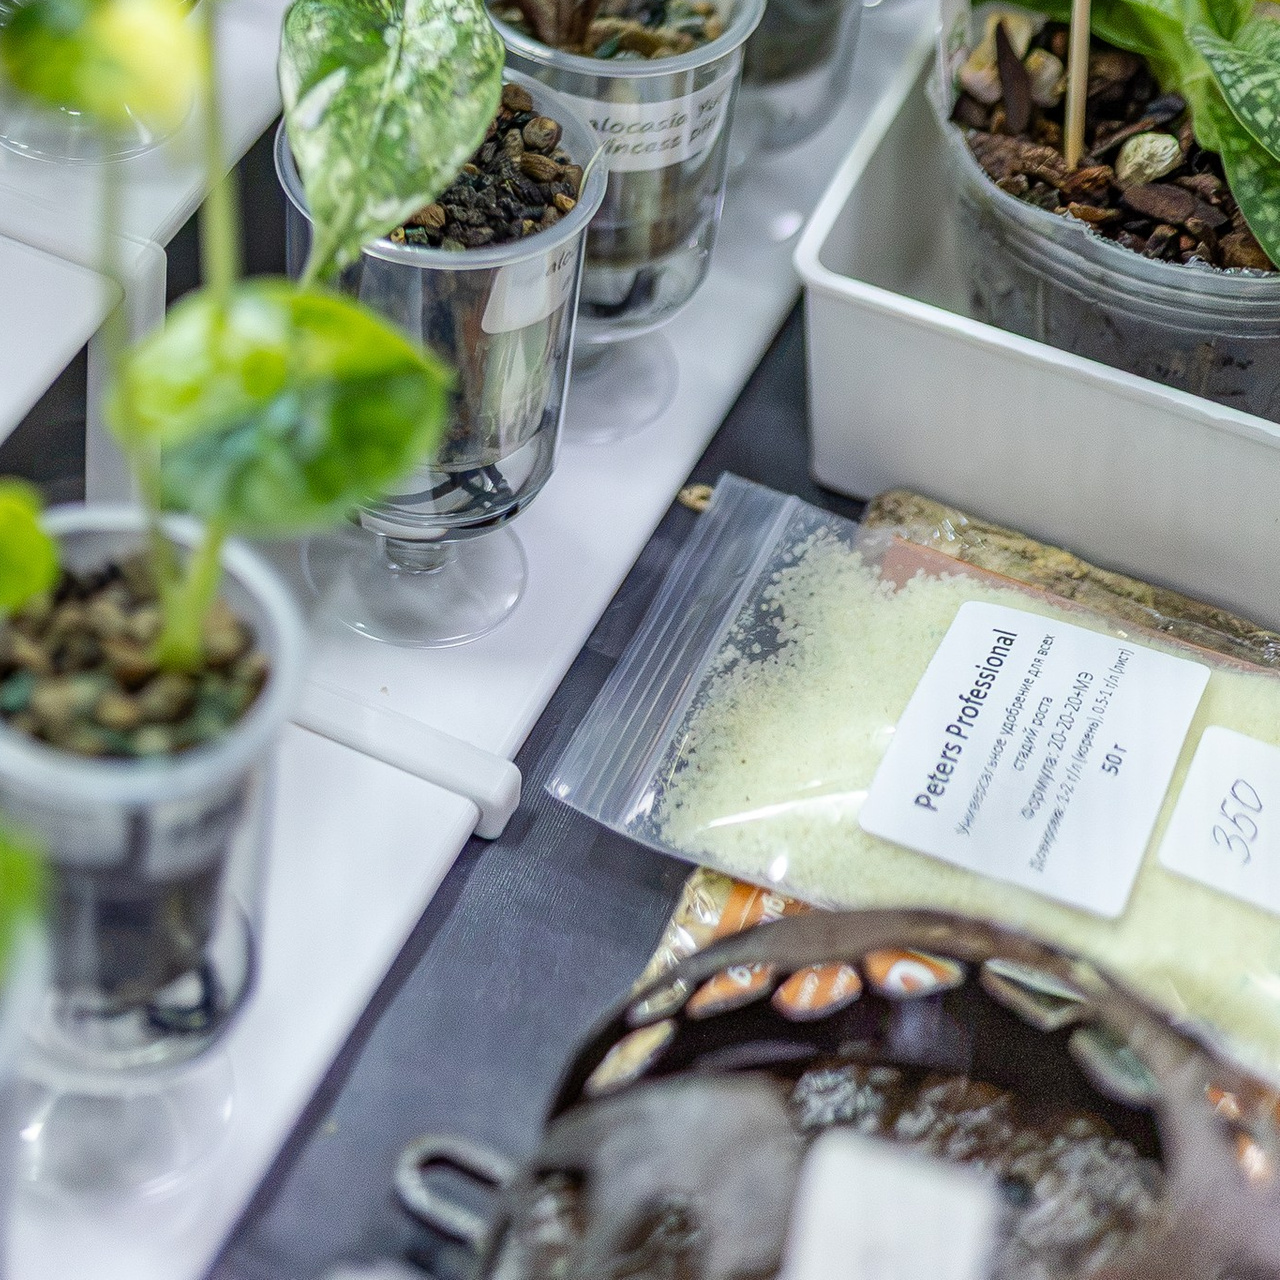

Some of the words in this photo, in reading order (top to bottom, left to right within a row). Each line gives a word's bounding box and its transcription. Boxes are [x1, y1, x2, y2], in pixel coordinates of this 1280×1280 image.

[1000, 677, 1035, 737] удобрение
[1027, 657, 1043, 678] для
[1036, 634, 1055, 657] всех
[1108, 647, 1135, 675] (лист)
[914, 742, 962, 812] Peters
[946, 628, 1018, 740] Professional
[1013, 726, 1038, 772] стадий
[1032, 696, 1054, 727] роста
[1046, 671, 1094, 752] 20-20-20+МЭ
[1101, 753, 1123, 776] 50
[1213, 778, 1263, 866] 350
